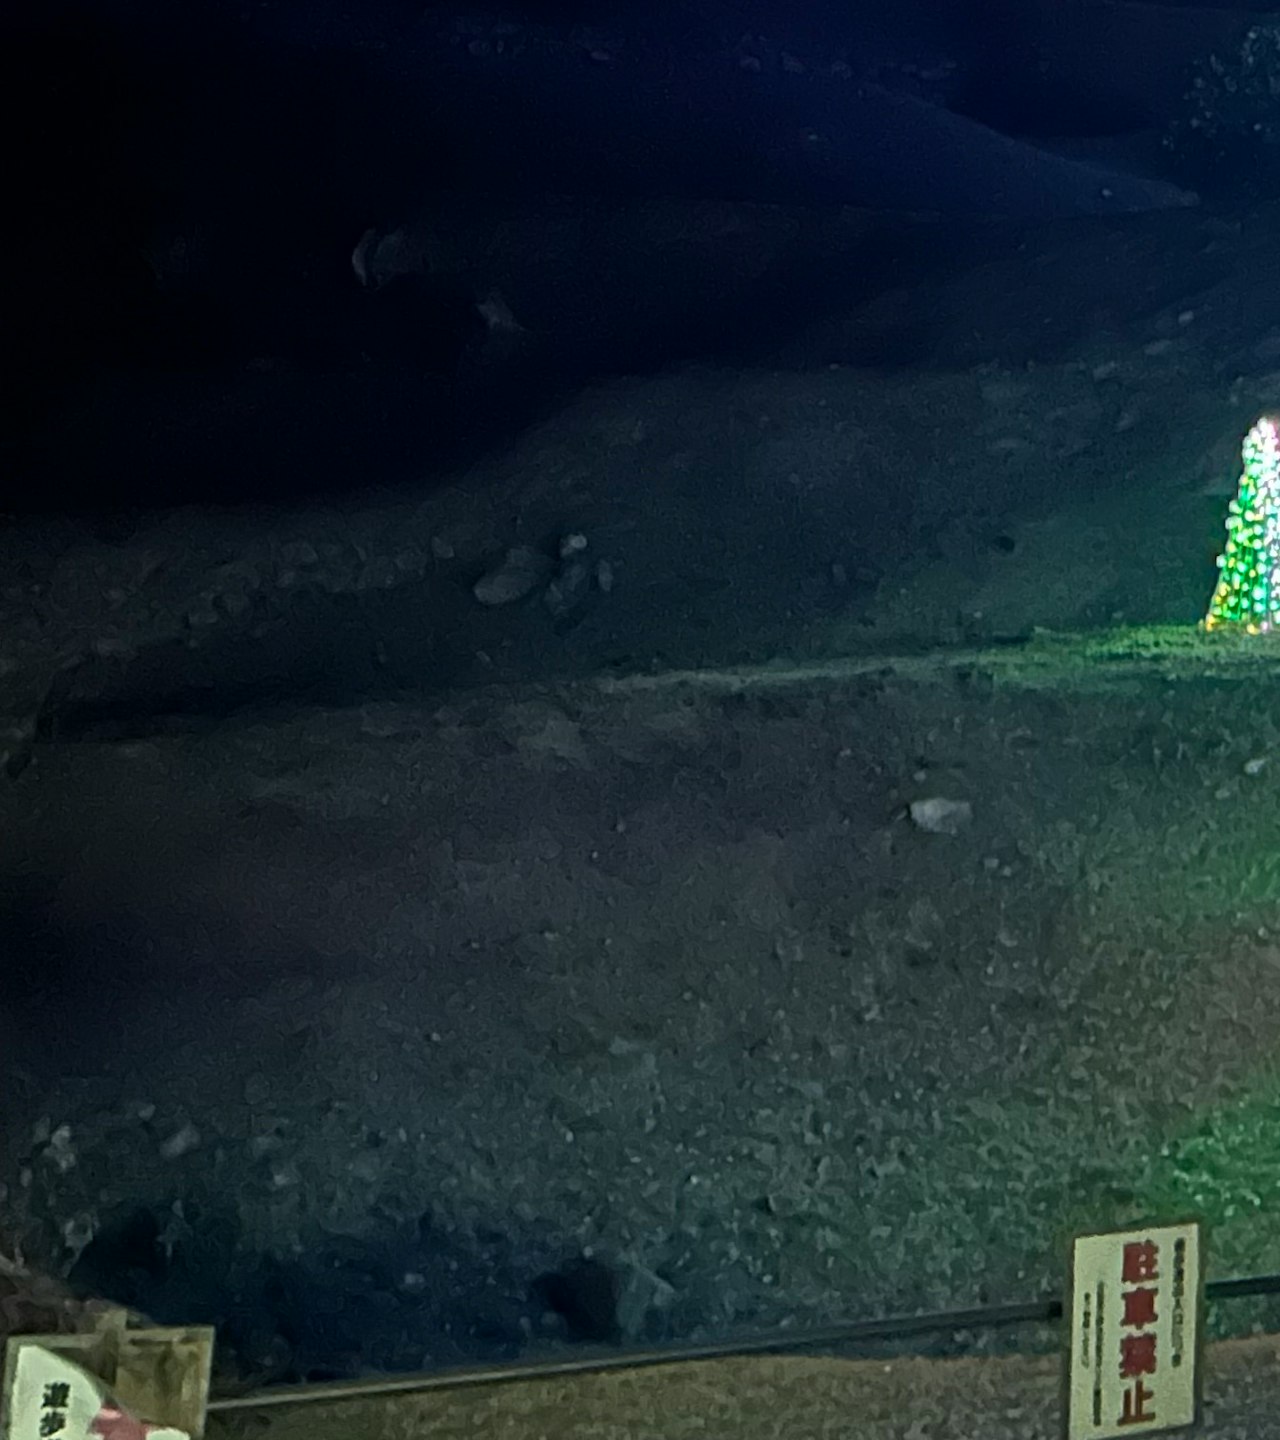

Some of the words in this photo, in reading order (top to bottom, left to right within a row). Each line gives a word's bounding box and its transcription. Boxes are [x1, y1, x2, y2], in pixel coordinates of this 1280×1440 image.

[1117, 1238, 1159, 1427] 駐車禁止
[39, 1381, 71, 1440] 遊歩
